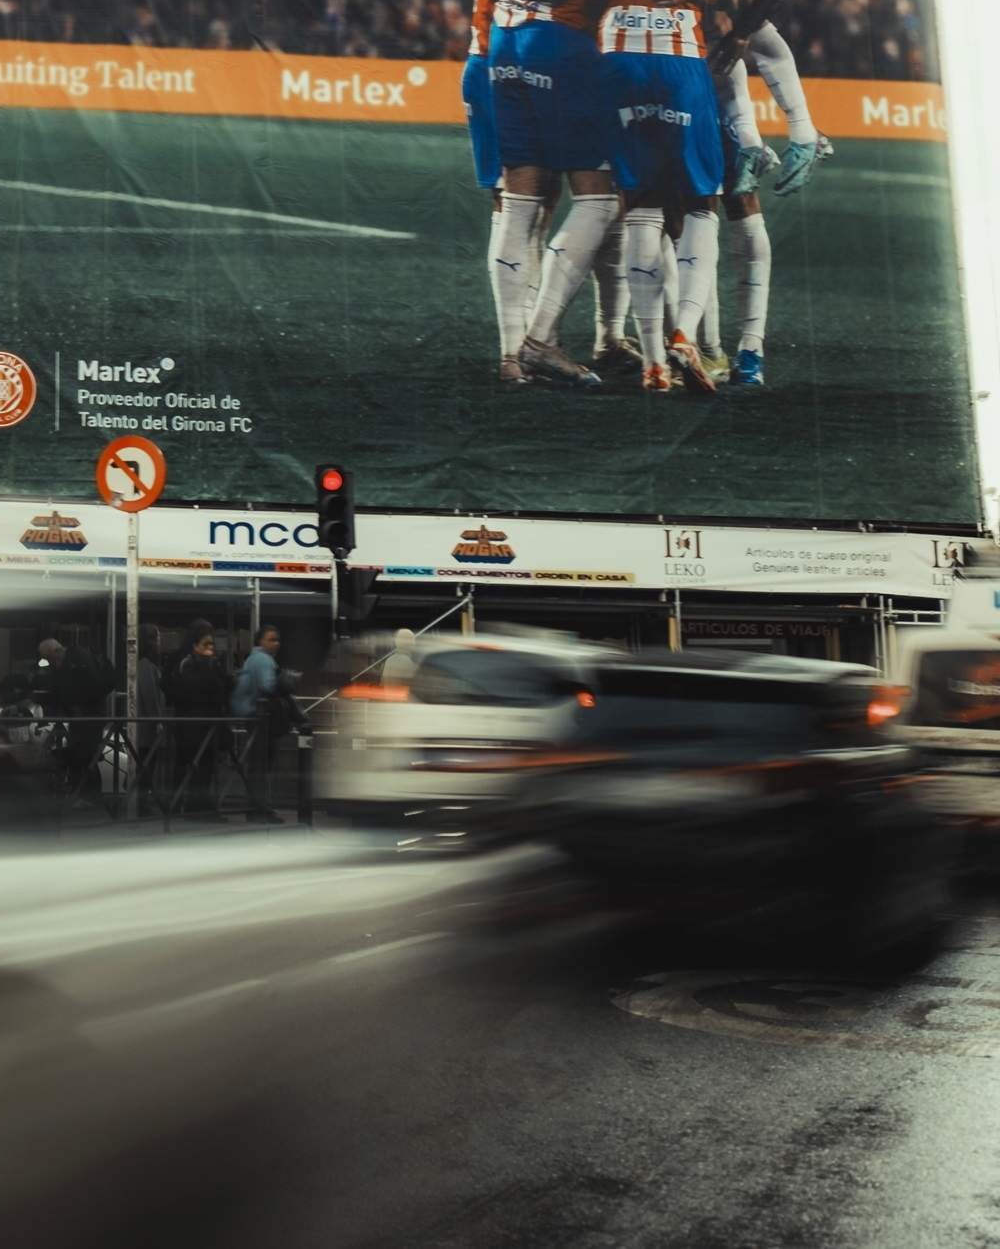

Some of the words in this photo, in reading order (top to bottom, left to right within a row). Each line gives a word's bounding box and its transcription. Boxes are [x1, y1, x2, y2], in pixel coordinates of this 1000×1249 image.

[611, 12, 676, 30] Marlex
[95, 61, 195, 93] Talent
[281, 69, 405, 107] Marlex
[77, 359, 161, 384] Marlex
[77, 389, 161, 407] Proveedor
[165, 392, 216, 409] Oficial
[220, 395, 241, 410] de
[78, 411, 138, 429] Talento
[142, 415, 168, 431] del
[172, 415, 225, 432] Girona
[230, 417, 252, 433] FC
[816, 551, 848, 561] cuero
[850, 551, 892, 564] original
[6, 556, 40, 564] MESA
[50, 557, 94, 565] COCINA
[140, 560, 211, 569] ALFOMBRAS
[386, 567, 434, 576] MENAJE
[437, 569, 531, 579] COMPLEMENTOS
[535, 572, 573, 580] ORDEN
[577, 573, 593, 581] EN
[595, 574, 628, 582] CASA
[664, 563, 706, 578] LEKO
[752, 561, 799, 573] Genuine
[803, 563, 842, 575] leather
[846, 565, 887, 577] articles
[764, 624, 784, 636] DE
